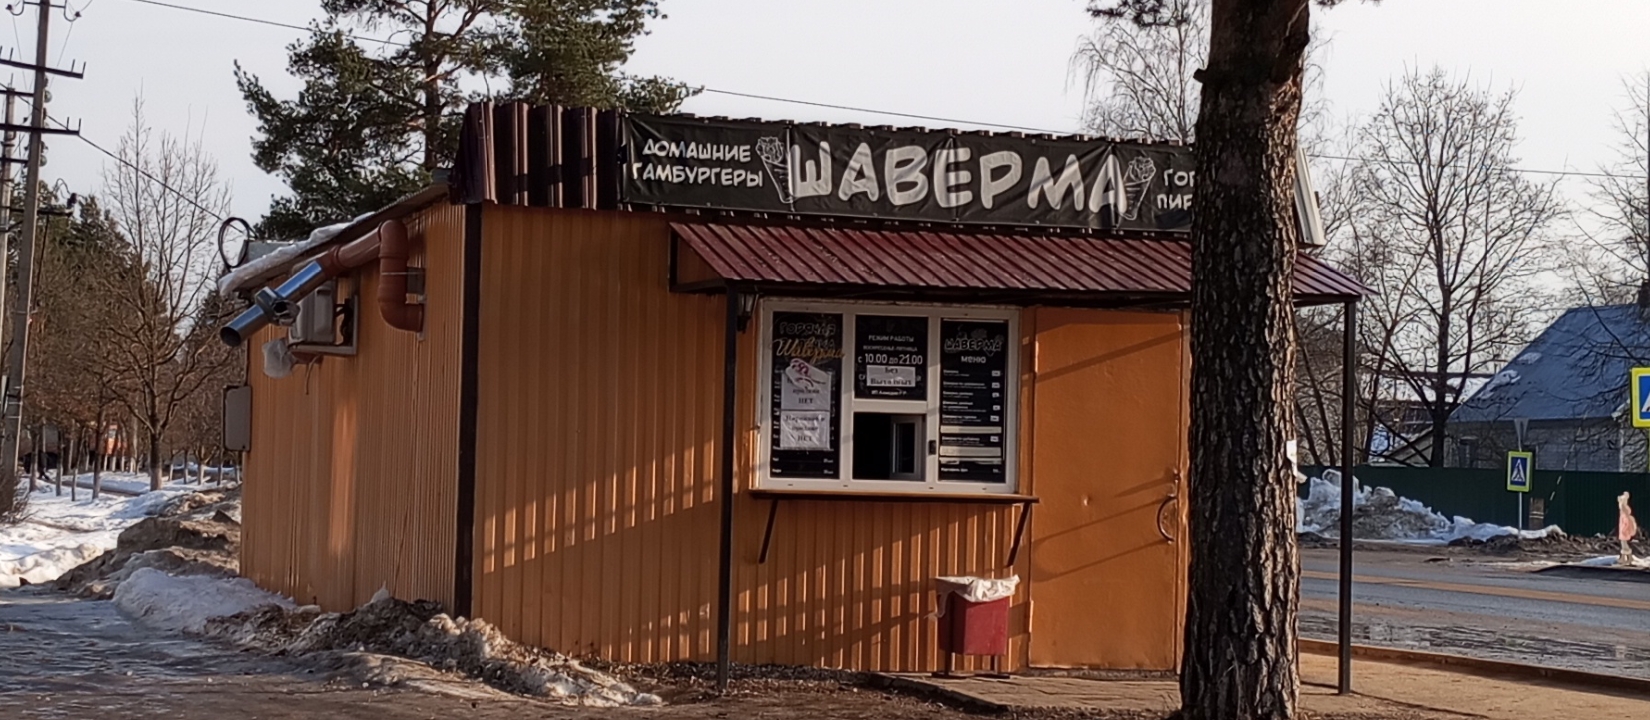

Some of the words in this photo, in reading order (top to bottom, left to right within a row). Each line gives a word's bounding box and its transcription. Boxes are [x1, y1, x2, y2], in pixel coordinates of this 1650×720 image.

[642, 138, 751, 163] ДОМАШНИЕ
[632, 162, 764, 188] ГАМБУРГЕРЫ
[788, 141, 1127, 213] ШАВЕРМА
[868, 334, 889, 342] РЕЖИМ
[890, 335, 914, 343] РАБОТЫ
[944, 338, 1002, 352] ШАВЕРМА
[865, 353, 888, 365] 10.00
